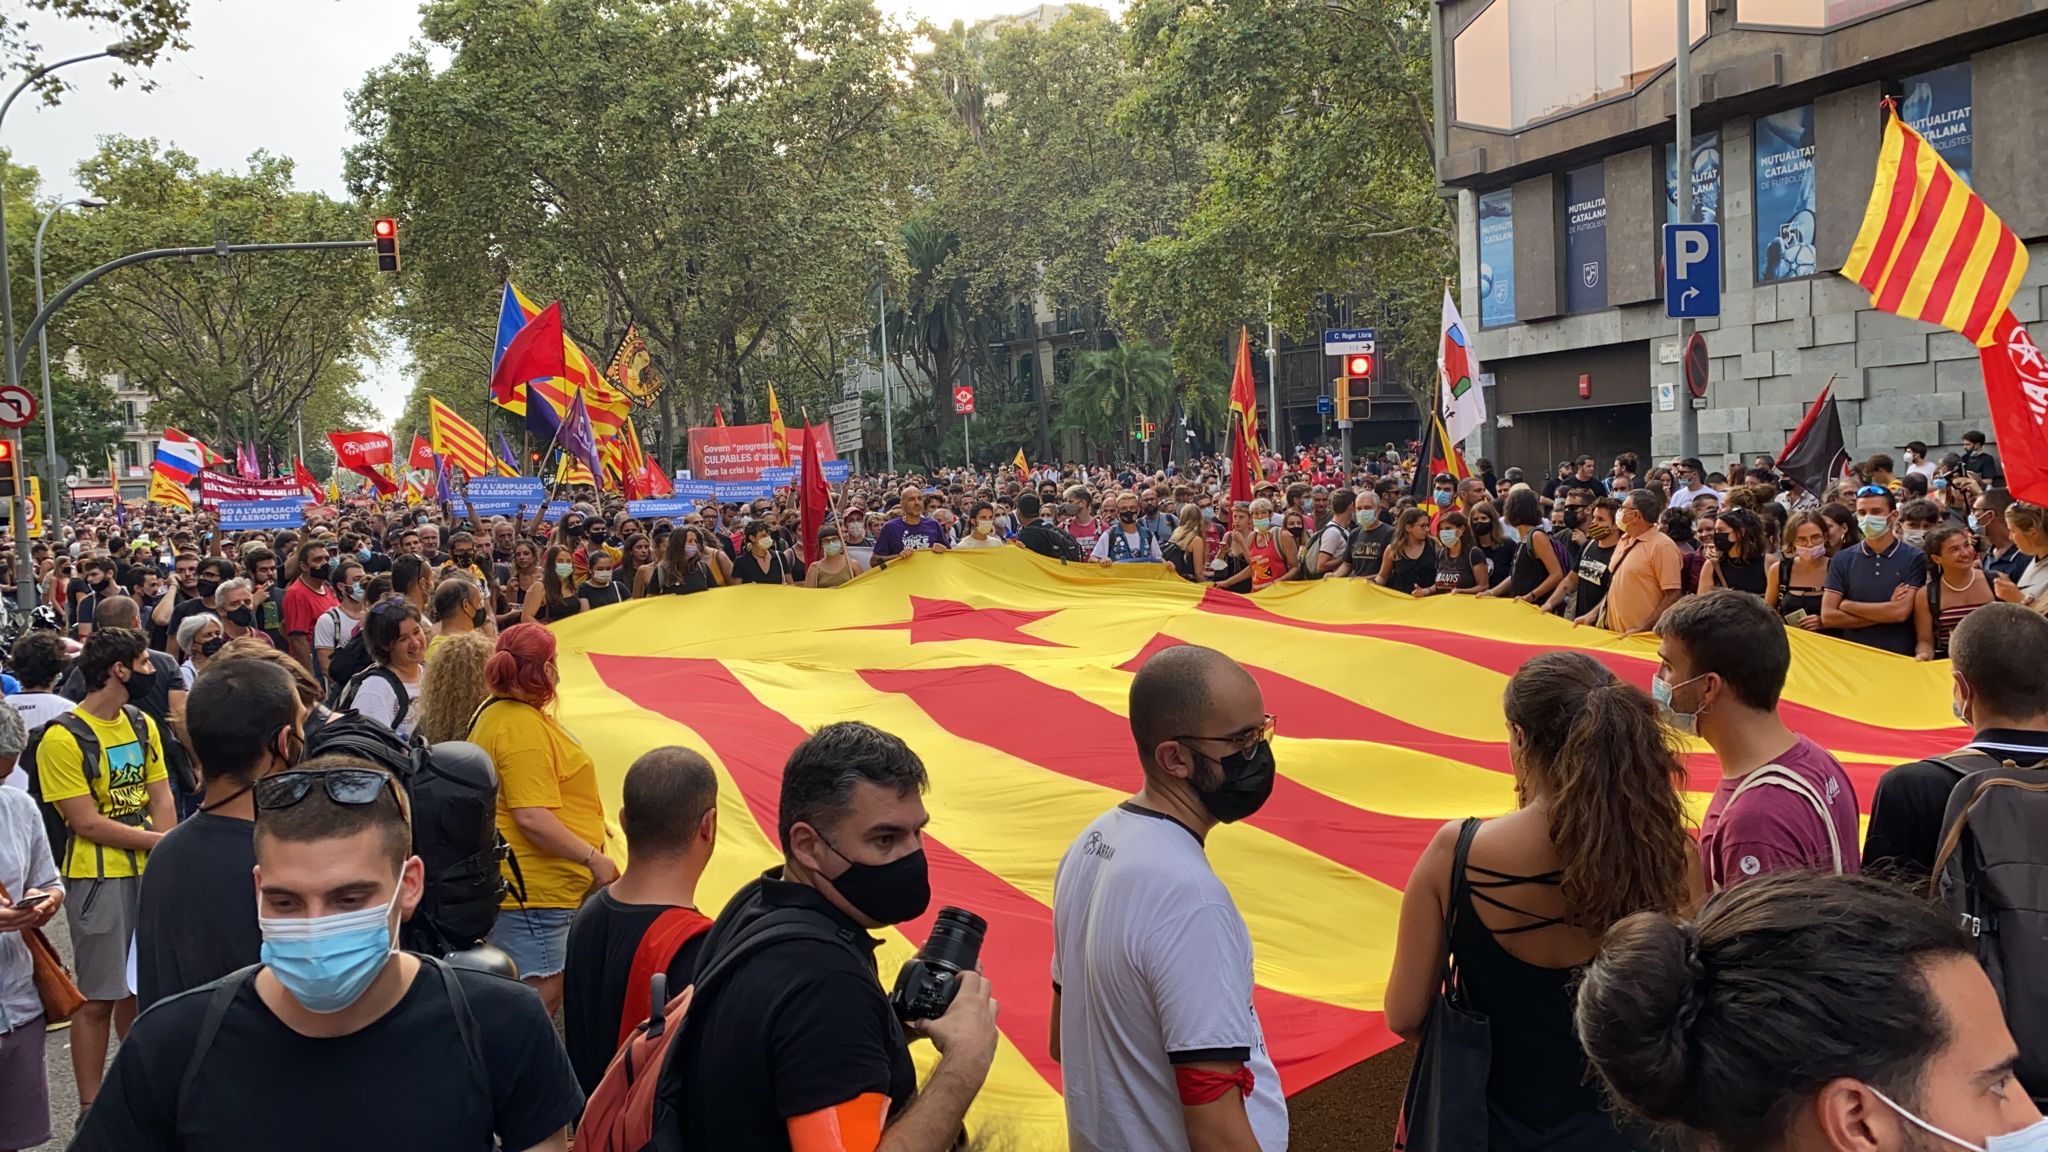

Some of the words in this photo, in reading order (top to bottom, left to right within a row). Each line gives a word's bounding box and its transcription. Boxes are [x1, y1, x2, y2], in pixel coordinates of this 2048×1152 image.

[1761, 146, 1815, 167] MUTUALITAT
[1765, 160, 1813, 178] CATALANA
[1761, 181, 1770, 190] DE
[1675, 231, 1709, 279] P
[359, 440, 388, 452] ARRAN
[704, 444, 730, 453] Govern
[704, 453, 751, 464] CULPABLES
[704, 467, 719, 476] Que
[730, 466, 745, 474] crisi
[490, 482, 544, 490] L'AMPLIACIÓ
[220, 507, 234, 515] NO
[244, 505, 301, 514] L'AMPLIACIÓ
